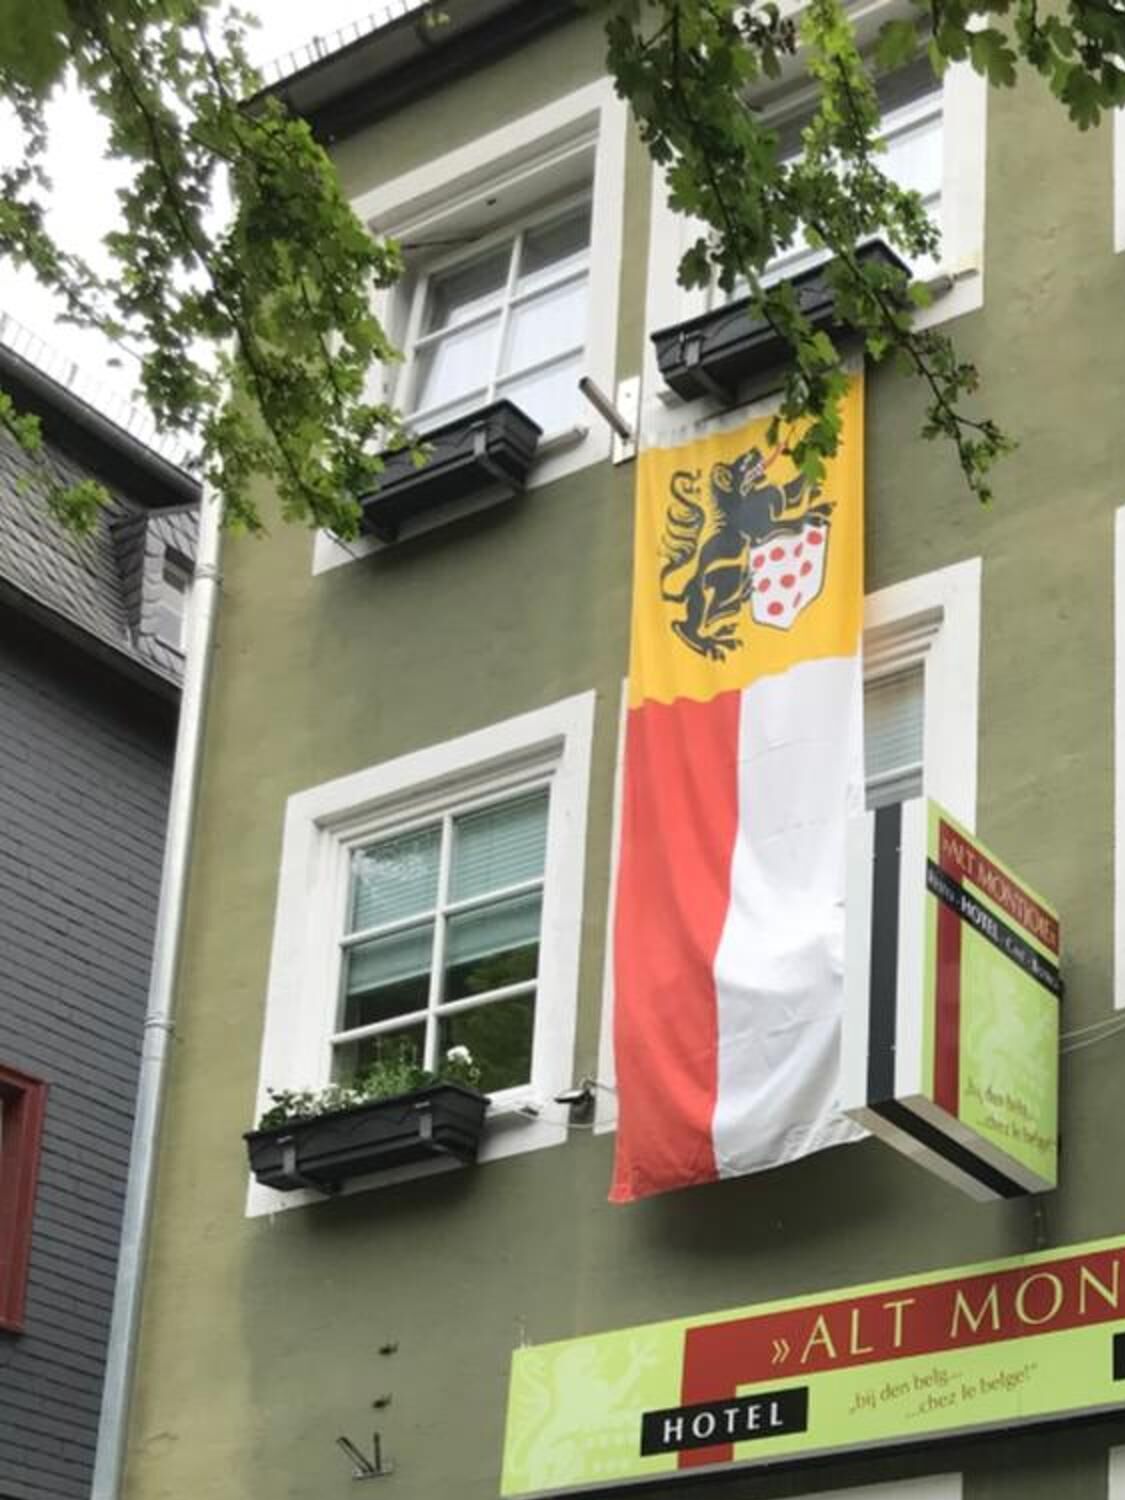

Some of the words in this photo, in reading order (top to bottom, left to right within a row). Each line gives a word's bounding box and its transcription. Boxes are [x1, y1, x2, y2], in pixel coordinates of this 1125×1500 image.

[880, 1381, 912, 1402] den
[960, 1383, 977, 1401] le
[662, 1401, 784, 1444] HOTEL
